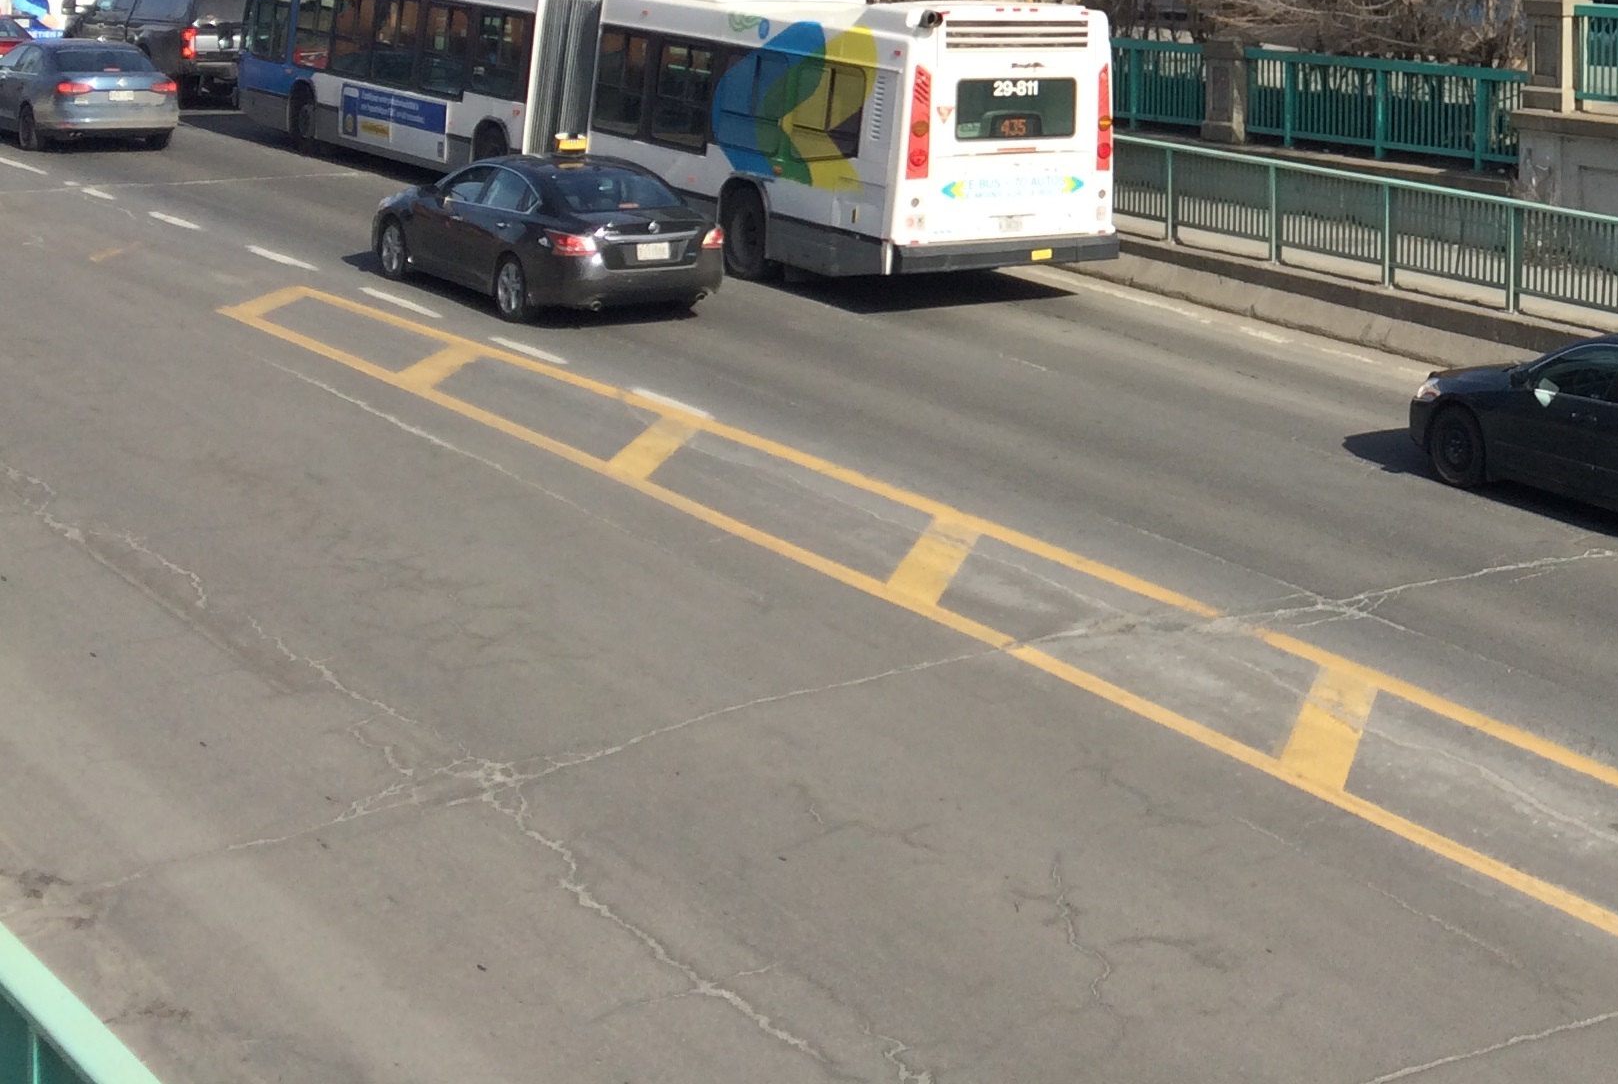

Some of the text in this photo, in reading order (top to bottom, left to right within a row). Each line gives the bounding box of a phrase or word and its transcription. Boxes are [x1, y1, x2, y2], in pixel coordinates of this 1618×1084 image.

[993, 80, 1039, 97] 29-811
[1001, 118, 1027, 137] 435
[979, 179, 1001, 189] BUS
[1031, 175, 1066, 187] AUTOS
